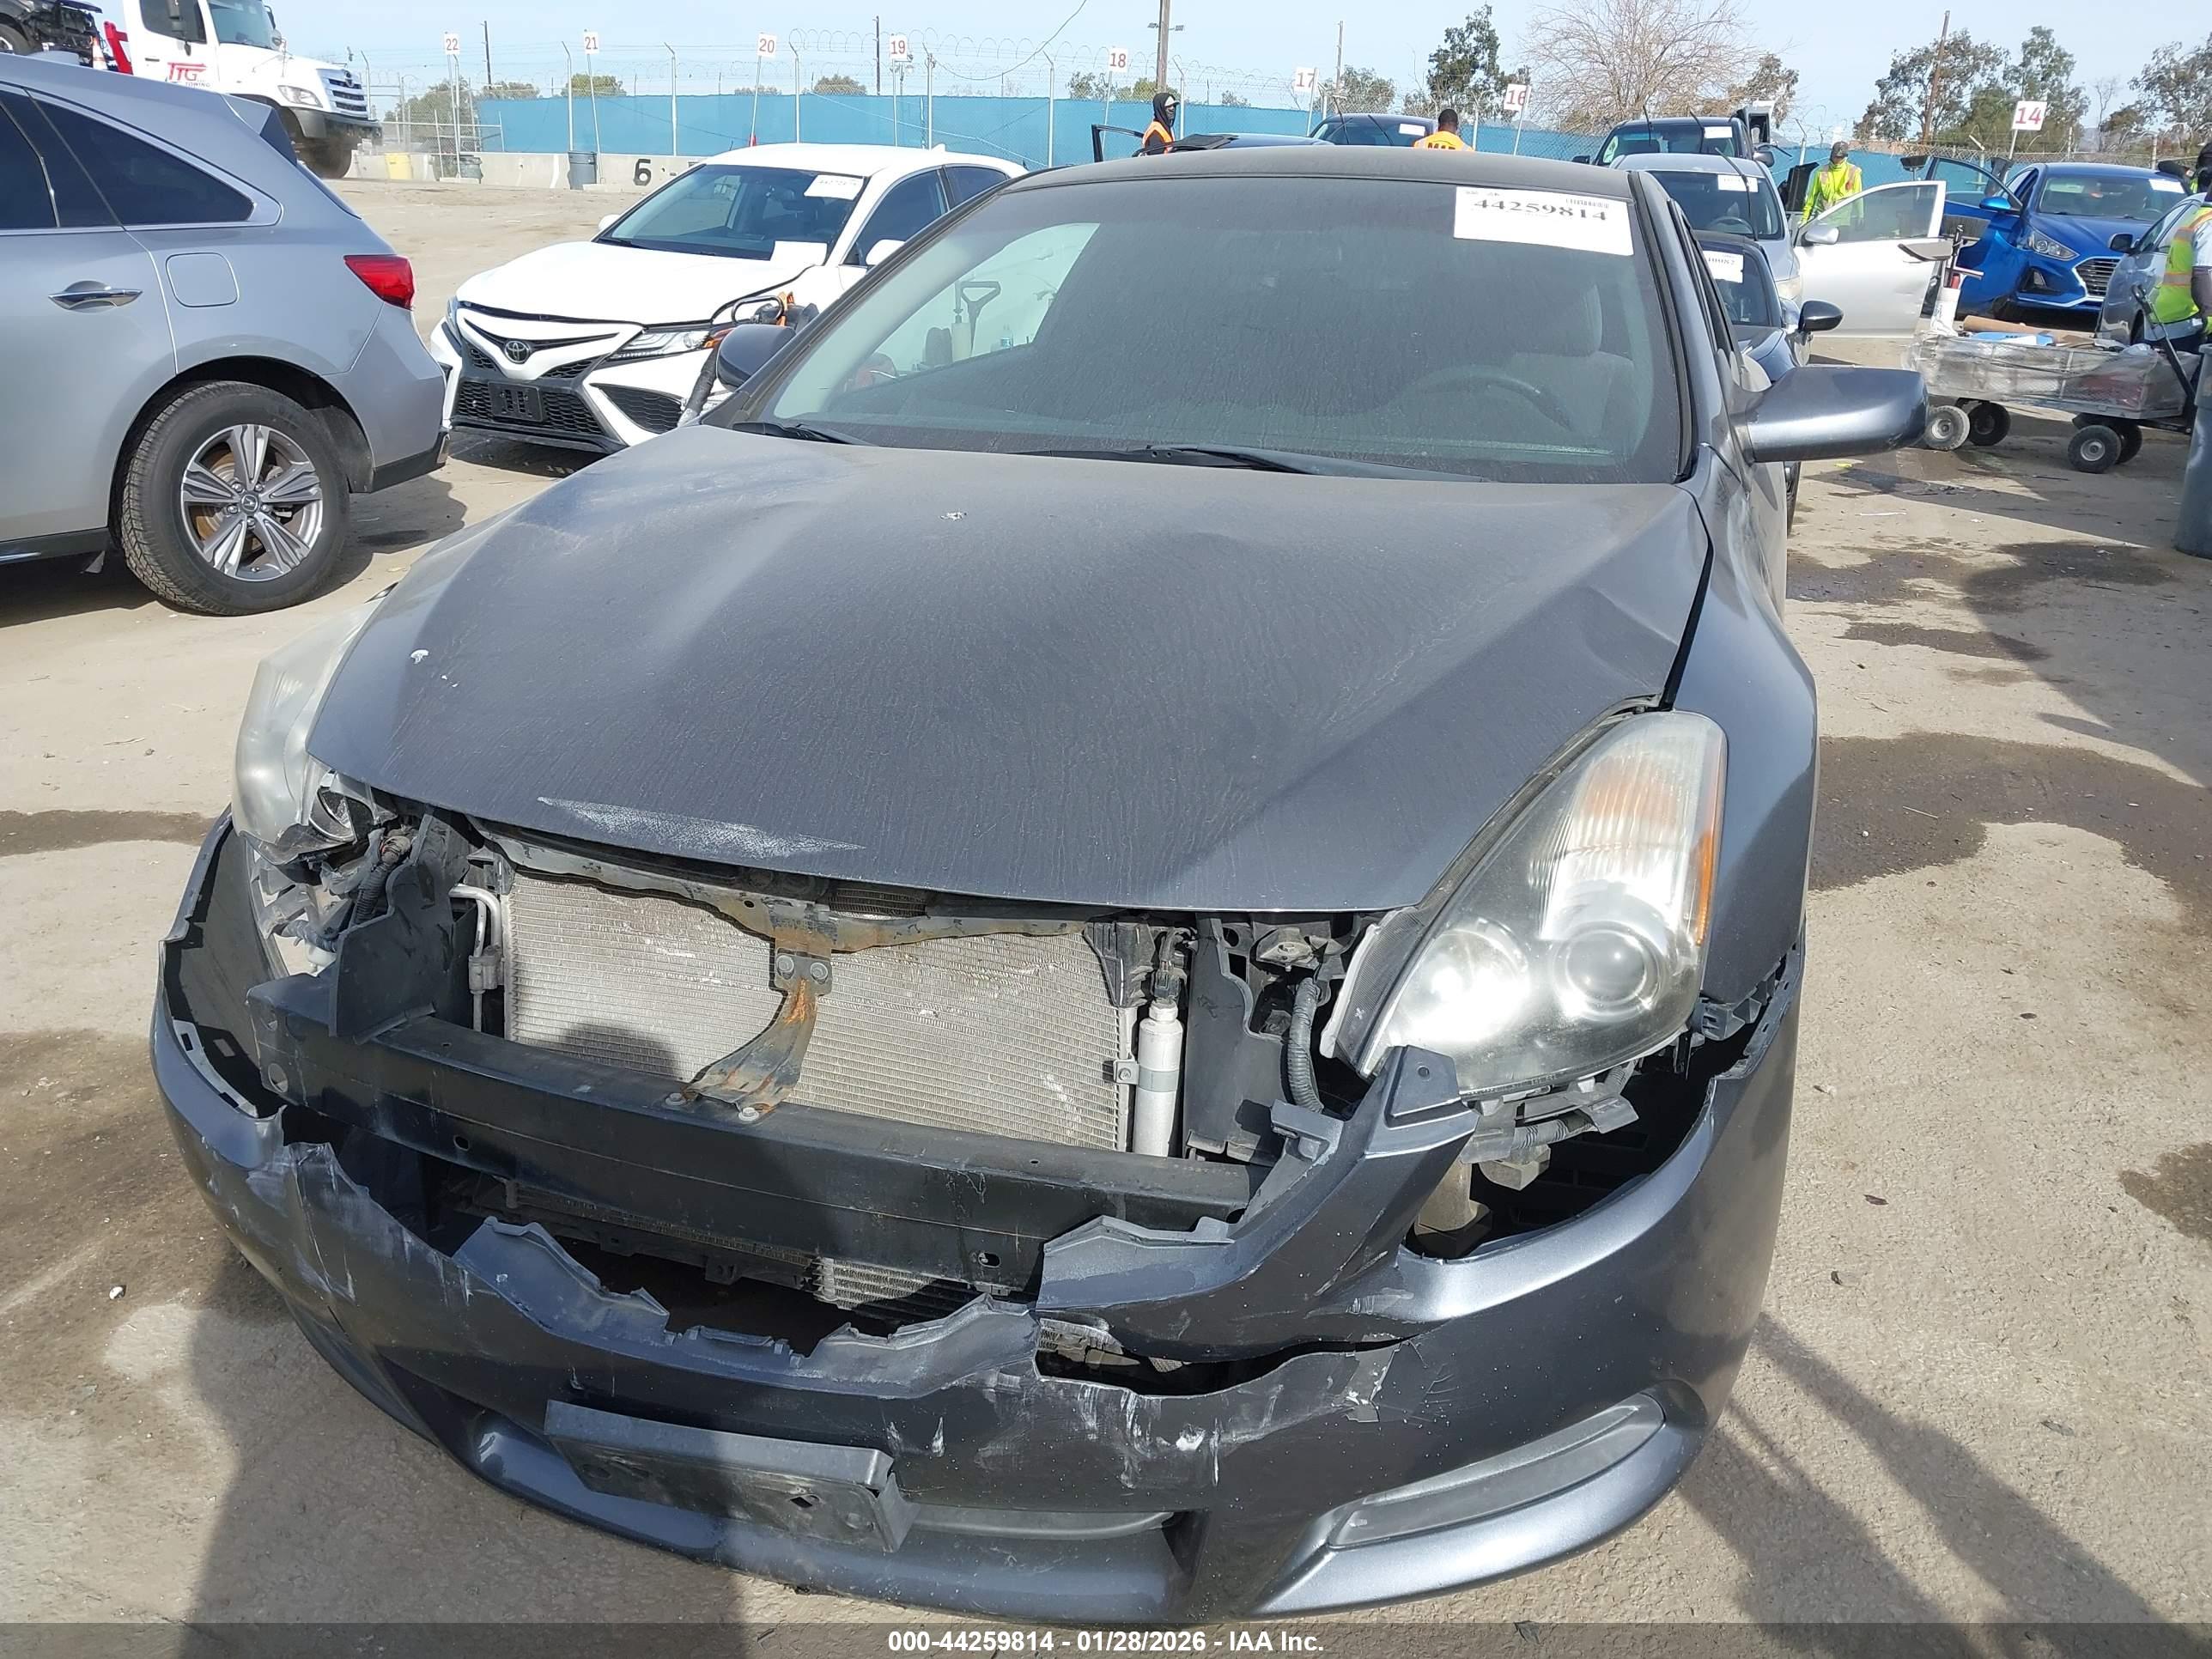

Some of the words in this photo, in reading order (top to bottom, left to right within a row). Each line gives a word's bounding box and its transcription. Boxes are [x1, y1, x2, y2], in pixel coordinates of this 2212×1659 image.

[446, 38, 459, 51] 22
[585, 36, 598, 50] 21
[759, 38, 775, 53] 20
[890, 40, 906, 54] 19
[1109, 52, 1126, 68] 18
[1296, 72, 1315, 88] 17
[1506, 90, 1526, 106] 16
[2014, 106, 2042, 125] 14
[633, 158, 652, 186] 6
[1474, 198, 1607, 221] 44259814
